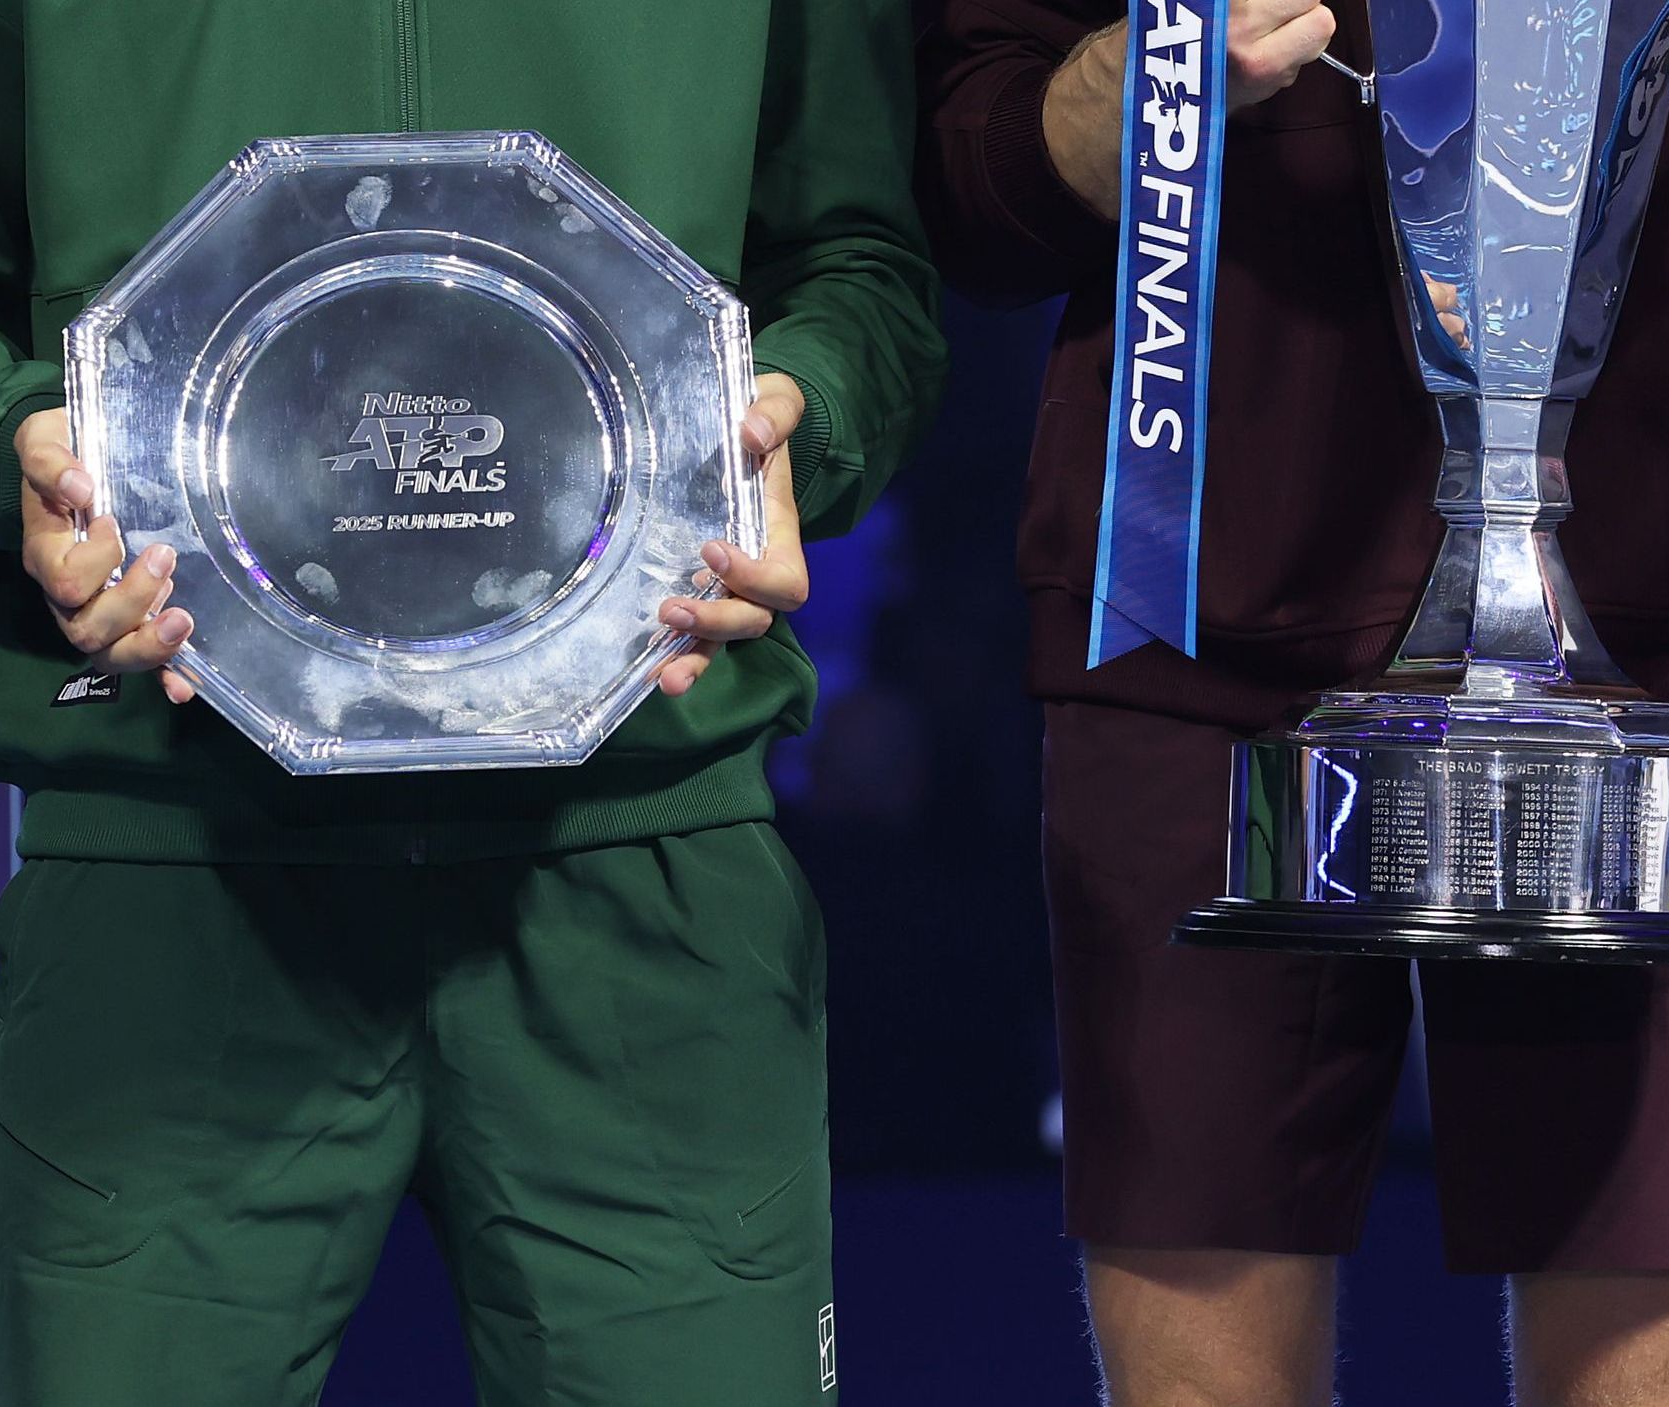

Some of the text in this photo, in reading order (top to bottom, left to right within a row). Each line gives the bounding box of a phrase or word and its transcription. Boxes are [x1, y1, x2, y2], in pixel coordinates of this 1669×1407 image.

[1130, 174, 1194, 454] FINALS
[362, 391, 471, 416] Nitto
[319, 414, 505, 471] ATP
[394, 468, 507, 494] FINALS
[332, 512, 516, 532] 2025 RUNNER-UP
[1418, 760, 1442, 772] THE
[1449, 762, 1482, 774] BRAD
[1372, 817, 1388, 825] 1974
